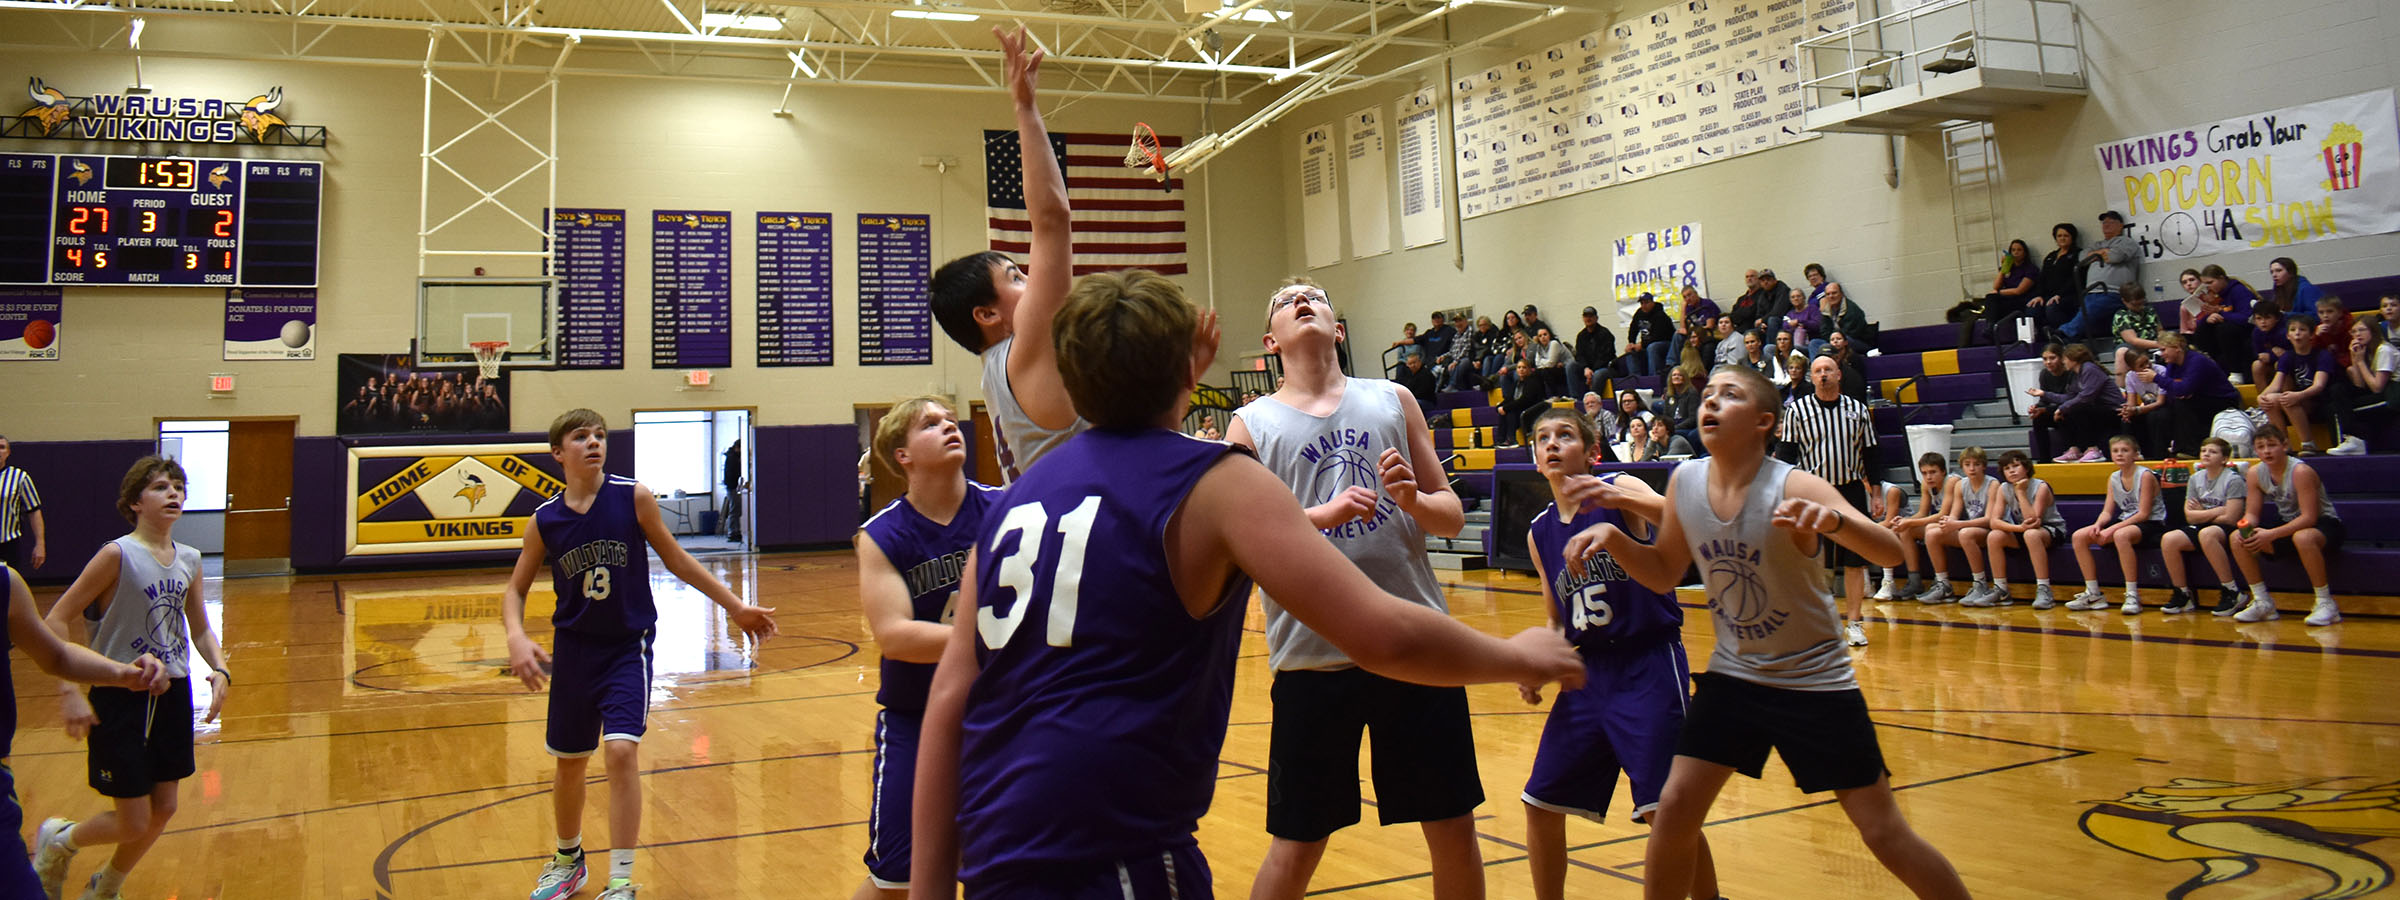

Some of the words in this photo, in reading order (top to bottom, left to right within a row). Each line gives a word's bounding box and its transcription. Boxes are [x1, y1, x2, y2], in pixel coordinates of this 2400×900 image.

[1734, 4, 1747, 15] PLAY
[1811, 11, 1825, 21] STATE
[1694, 18, 1706, 28] PLAY
[1725, 10, 1759, 27] PRODUCTION
[1775, 13, 1789, 24] CLASS
[1656, 31, 1667, 40] PLAY
[1685, 23, 1717, 40] PRODUCTION
[1733, 28, 1746, 37] CLASS
[1767, 25, 1780, 35] STATE
[1648, 36, 1678, 52] PRODUCTION
[1725, 38, 1738, 48] STATE
[1738, 31, 1762, 44] CHAMPION
[1611, 48, 1640, 64] PRODUCTION
[1697, 44, 1720, 56] CHAMPION
[1735, 90, 1749, 101] STATE
[1751, 86, 1764, 96] PLAY
[1778, 84, 1791, 96] STATE
[94, 94, 224, 119] WAUSA
[1733, 95, 1767, 110] PRODUCTION
[1784, 101, 1799, 111] CLASS
[1410, 109, 1436, 123] PRODUCTION
[1699, 104, 1718, 117] SPEECH
[1741, 113, 1754, 122] CLASS
[1775, 112, 1789, 122] STATE
[1662, 113, 1687, 126] PRODUCTION
[1732, 123, 1745, 133] STATE
[1745, 116, 1773, 130] CHAMPIONS
[79, 117, 237, 143] VIKINGS
[1624, 126, 1640, 137] SPEECH
[1692, 134, 1704, 142] STATE
[1704, 127, 1730, 140] CHAMPIONS
[1590, 133, 1612, 145] PRODUCTION
[2099, 130, 2199, 171] VIKINGS
[2207, 120, 2262, 154] Grab
[2263, 116, 2308, 147] Your
[8, 159, 22, 169] FLS
[32, 160, 47, 170] PTS
[252, 166, 270, 176] PLYR
[277, 167, 290, 177] FLS
[299, 168, 313, 177] PTS
[140, 161, 194, 188] 1:53
[2124, 155, 2273, 216] POPCORN
[67, 191, 106, 203] HOME
[133, 199, 166, 209] PERIOD
[191, 193, 233, 207] GUEST
[70, 207, 109, 235] 27
[142, 211, 157, 233] 3
[214, 210, 233, 237] 2
[701, 215, 727, 223] TRACK
[760, 216, 786, 224] GIRLS
[861, 218, 886, 226] GIRLS
[2245, 196, 2337, 248] SHOW
[57, 237, 86, 246] FOULS
[118, 238, 151, 247] PLAYER
[156, 238, 179, 248] FOUL
[207, 239, 236, 249] FOULS
[1615, 235, 1635, 257] WE
[1648, 225, 1691, 252] BLEED
[67, 249, 82, 267] 4
[95, 252, 107, 269] 5
[186, 253, 197, 270] 3
[224, 251, 231, 269] 1
[55, 273, 84, 282] SCORE
[129, 273, 159, 283] MATCH
[205, 274, 233, 284] SCORE
[1616, 264, 1679, 302] PURPLE
[1683, 260, 1698, 287] &
[228, 314, 245, 322] ACE
[216, 377, 233, 390] EXIT
[1301, 428, 1369, 464] WAUSA
[369, 463, 431, 507] HOME
[502, 457, 529, 478] OF
[536, 474, 561, 496] TH
[424, 521, 514, 538] VIKINGS
[559, 540, 628, 580] WILDCATS
[1700, 539, 1762, 566] WAUSA
[977, 496, 1102, 650] 31
[144, 579, 188, 601] WAUSA
[583, 567, 611, 601] 43
[1572, 583, 1614, 631] 45
[1708, 598, 1790, 641] BASKETBALL
